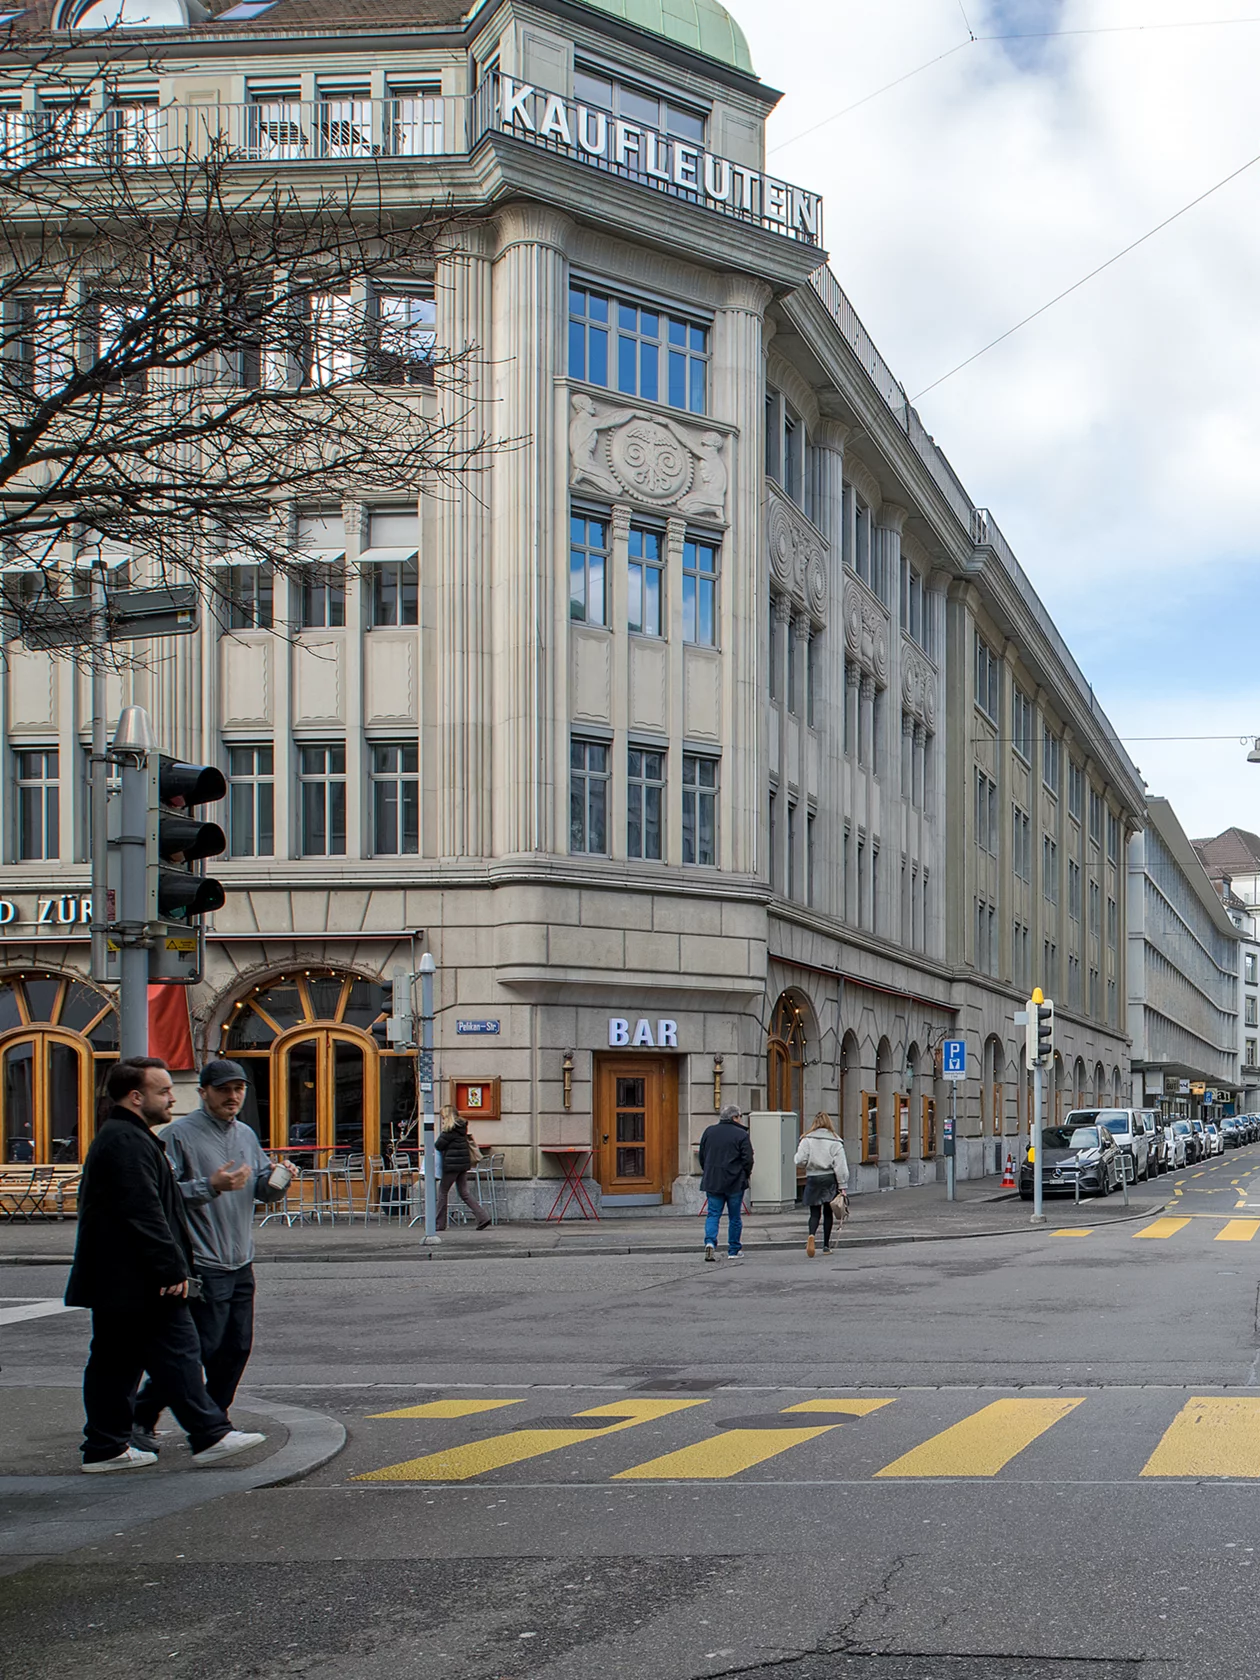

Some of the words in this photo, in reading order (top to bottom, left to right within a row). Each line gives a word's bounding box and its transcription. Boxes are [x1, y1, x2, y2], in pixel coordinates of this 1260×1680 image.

[501, 76, 818, 235] KAUFLEUTEN
[609, 1018, 678, 1047] BAR
[950, 1043, 960, 1058] P
